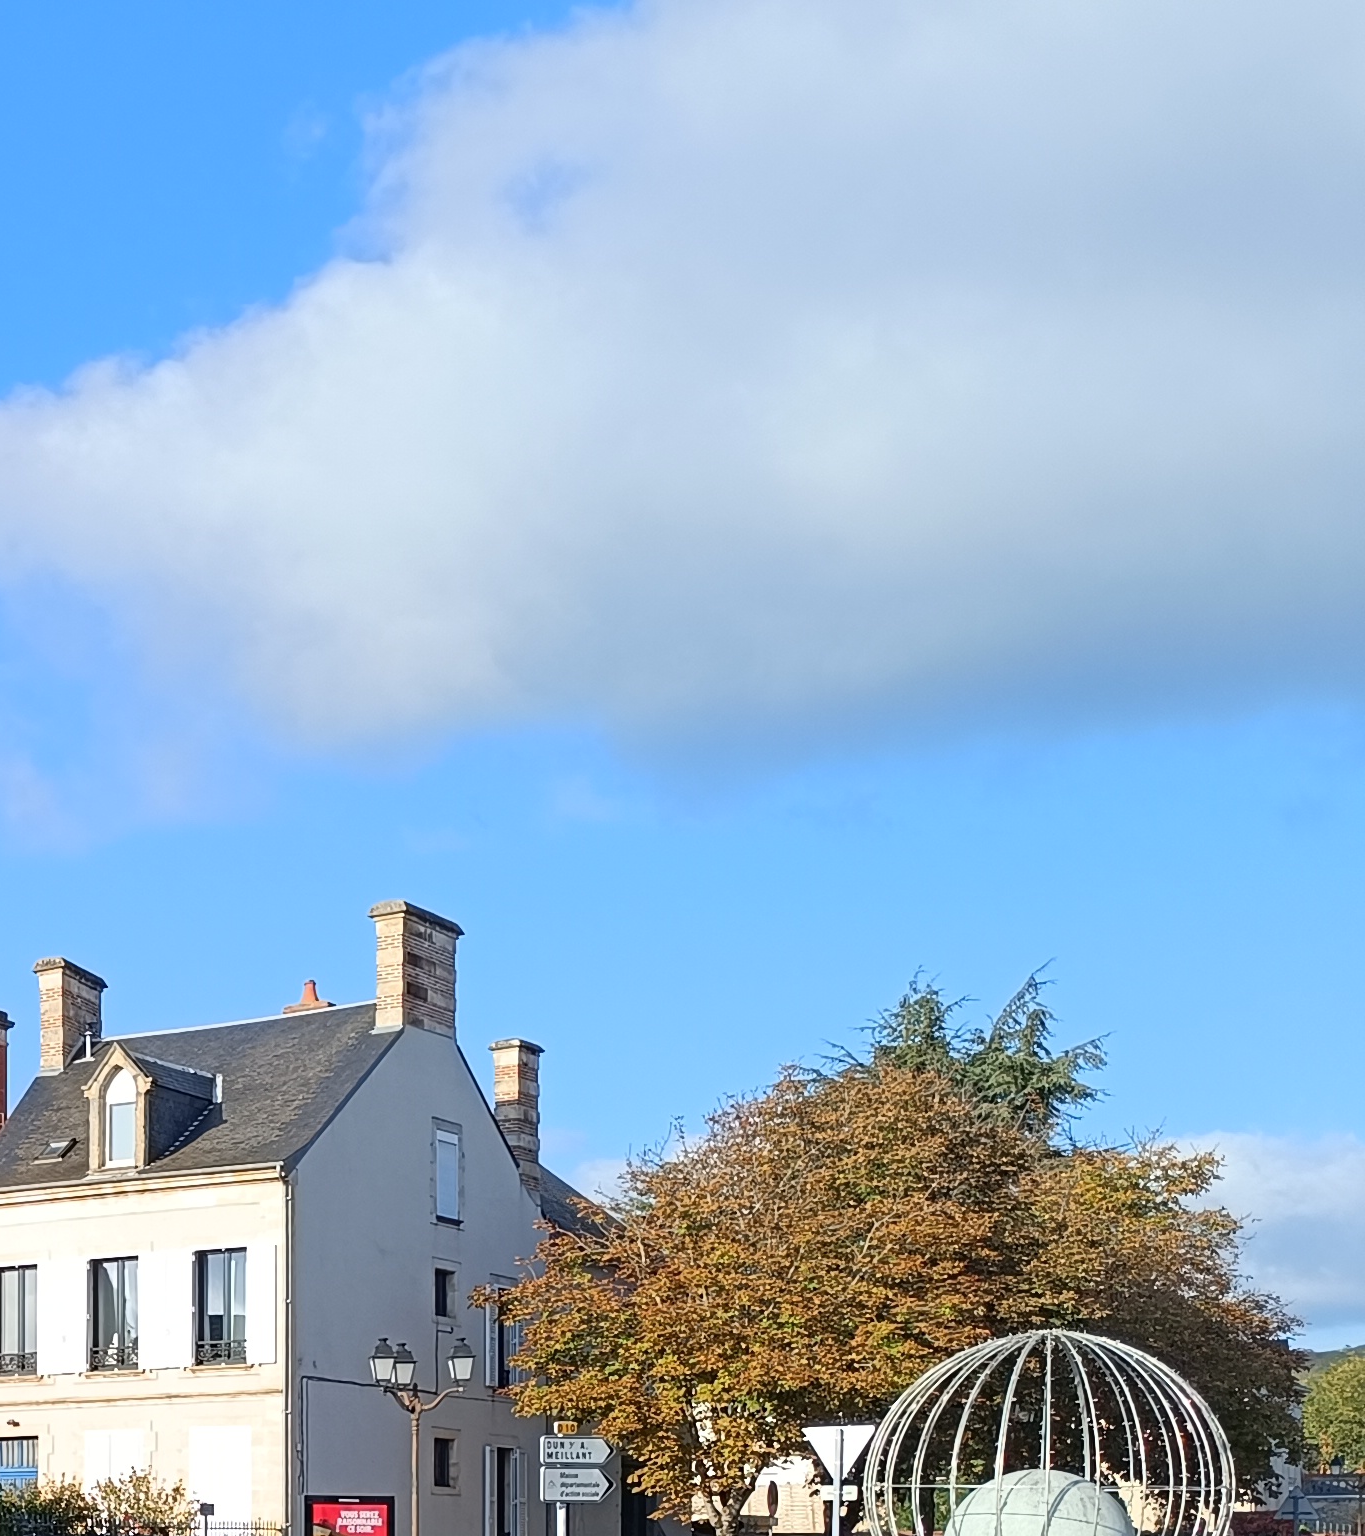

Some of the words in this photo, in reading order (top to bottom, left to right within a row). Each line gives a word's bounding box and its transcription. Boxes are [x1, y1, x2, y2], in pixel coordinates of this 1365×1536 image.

[557, 1424, 563, 1432] D
[565, 1424, 576, 1432] 10
[546, 1441, 565, 1449] DUN
[546, 1452, 592, 1460] MEILLANT
